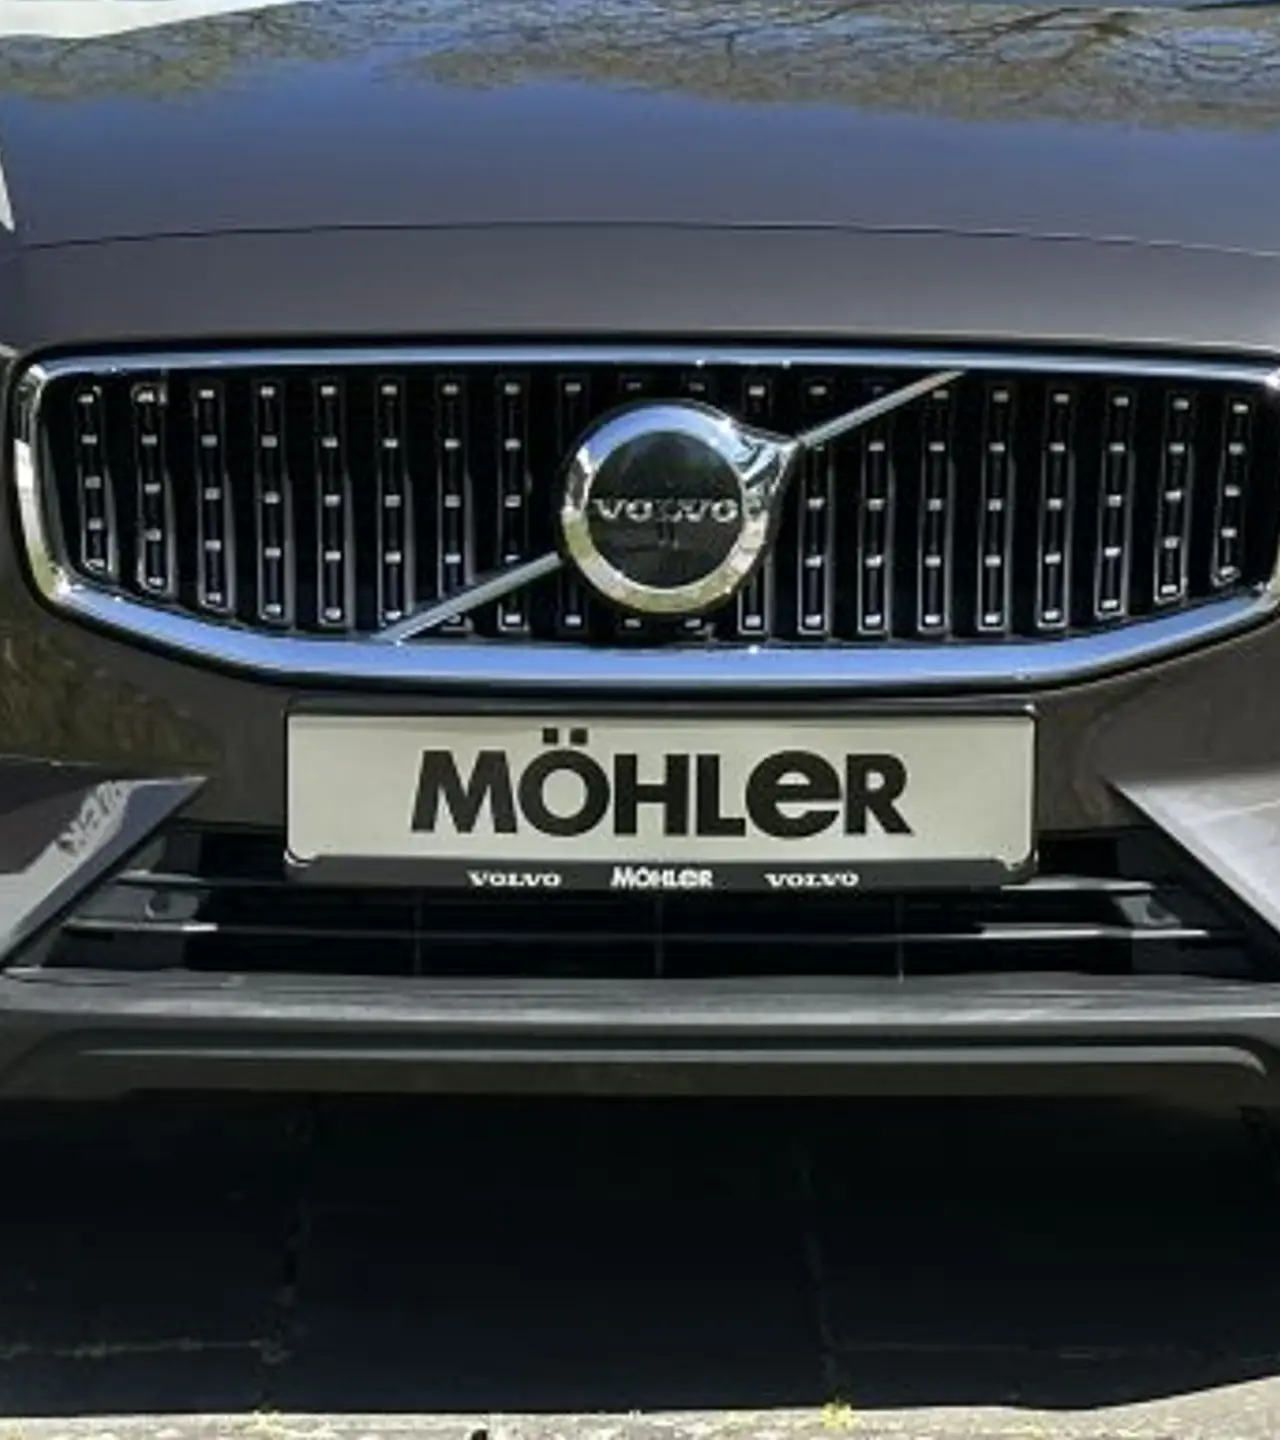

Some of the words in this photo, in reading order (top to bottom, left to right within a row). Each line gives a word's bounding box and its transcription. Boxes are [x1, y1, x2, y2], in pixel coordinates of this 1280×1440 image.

[592, 497, 740, 523] VOLVO
[467, 870, 562, 888] VOLVO
[764, 871, 860, 888] VOLVO
